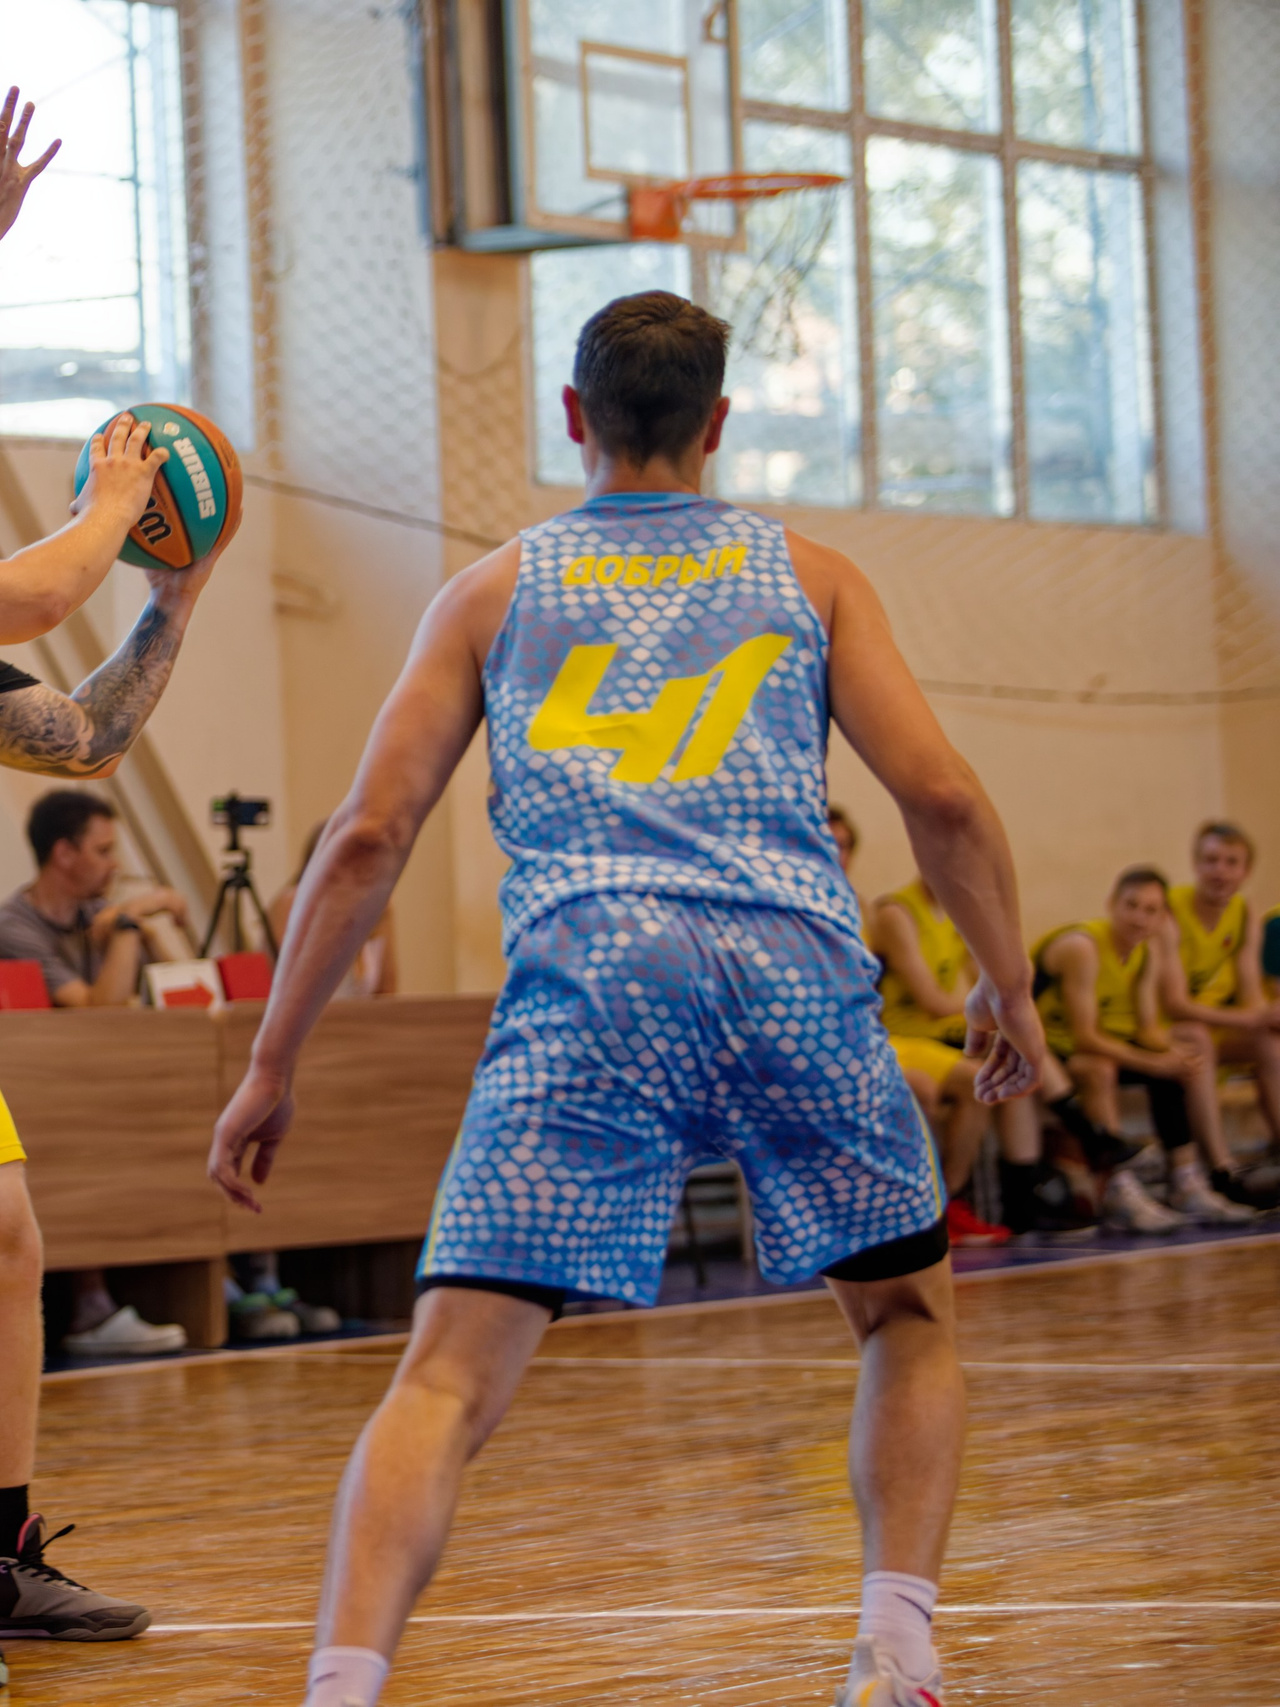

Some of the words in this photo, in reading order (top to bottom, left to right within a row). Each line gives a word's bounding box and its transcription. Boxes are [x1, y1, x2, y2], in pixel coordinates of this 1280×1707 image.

[172, 437, 217, 520] SIBUR
[561, 540, 749, 588] ДОБРЫЙ
[527, 632, 793, 784] 41
